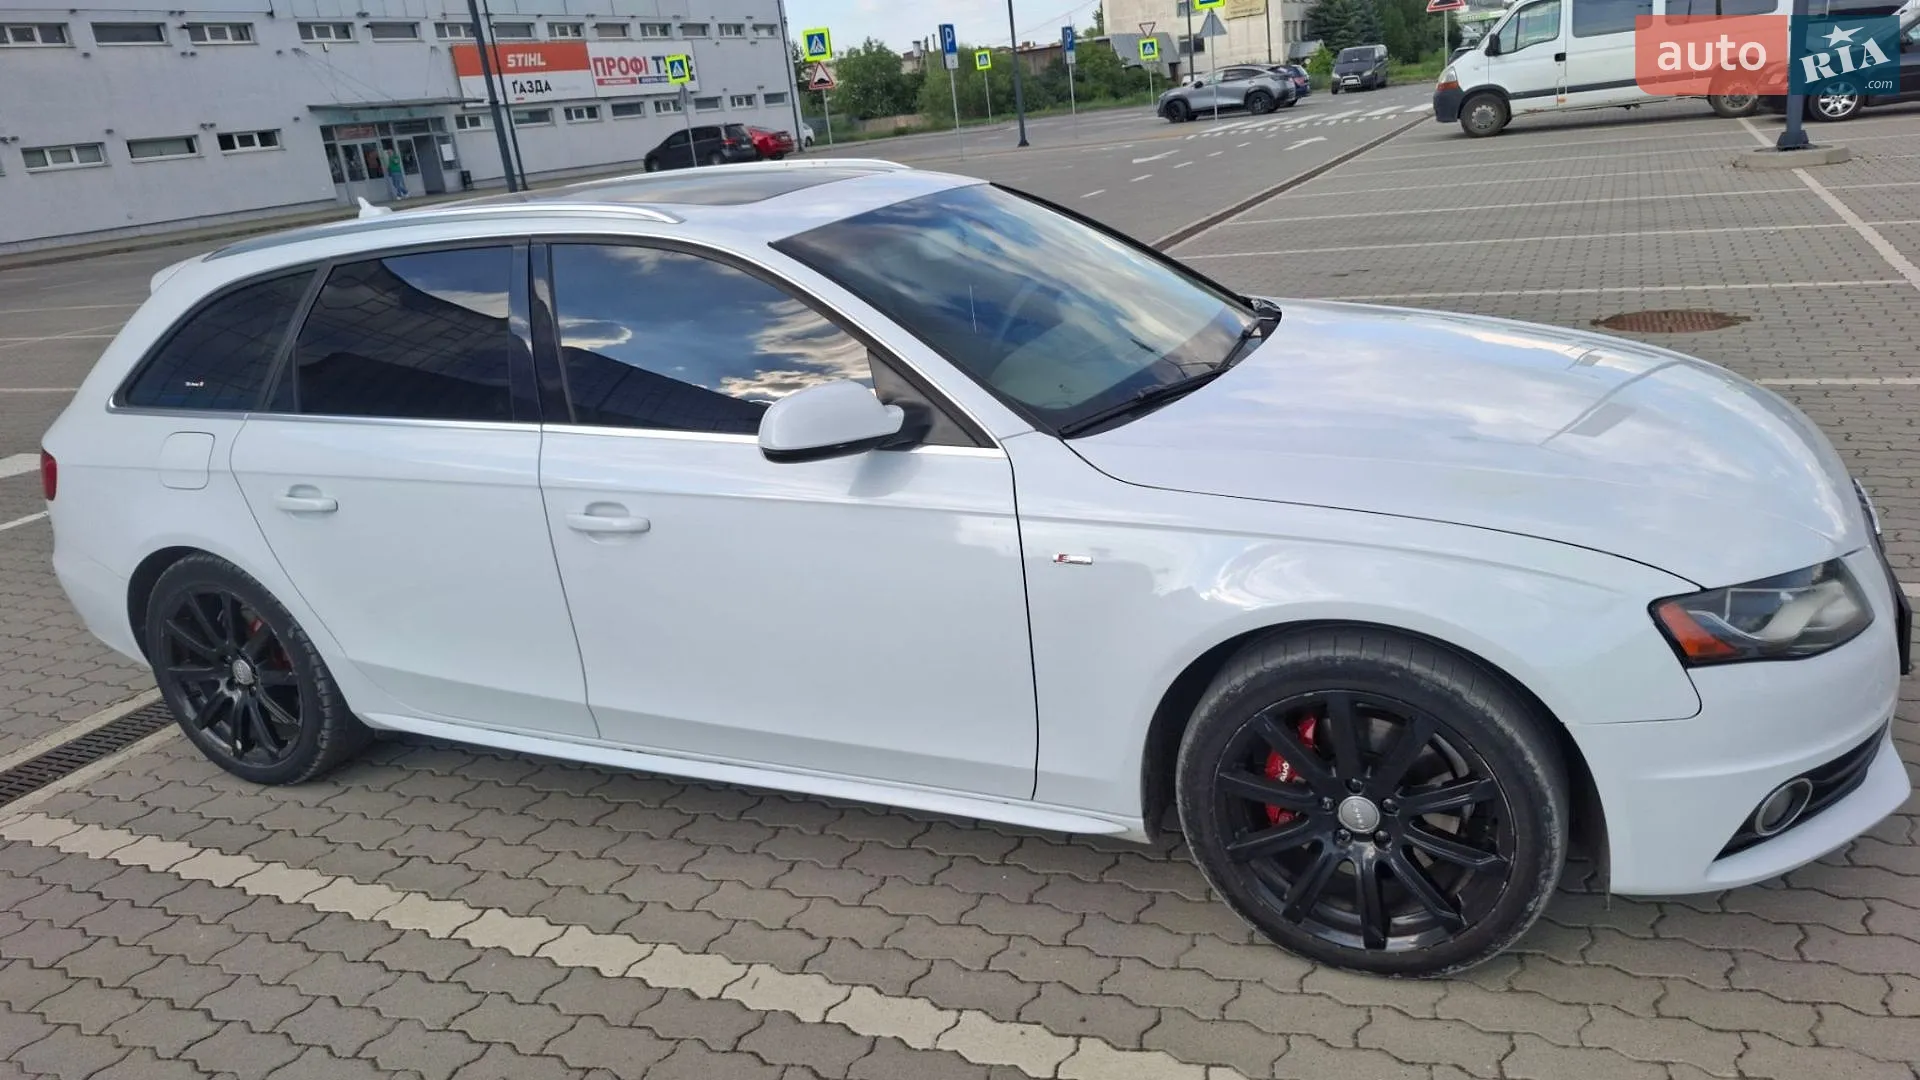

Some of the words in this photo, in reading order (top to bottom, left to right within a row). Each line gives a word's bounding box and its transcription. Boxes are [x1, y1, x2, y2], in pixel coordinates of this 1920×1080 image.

[944, 27, 953, 50] P
[507, 52, 546, 68] STIHL
[592, 56, 649, 76] ПРОФІ
